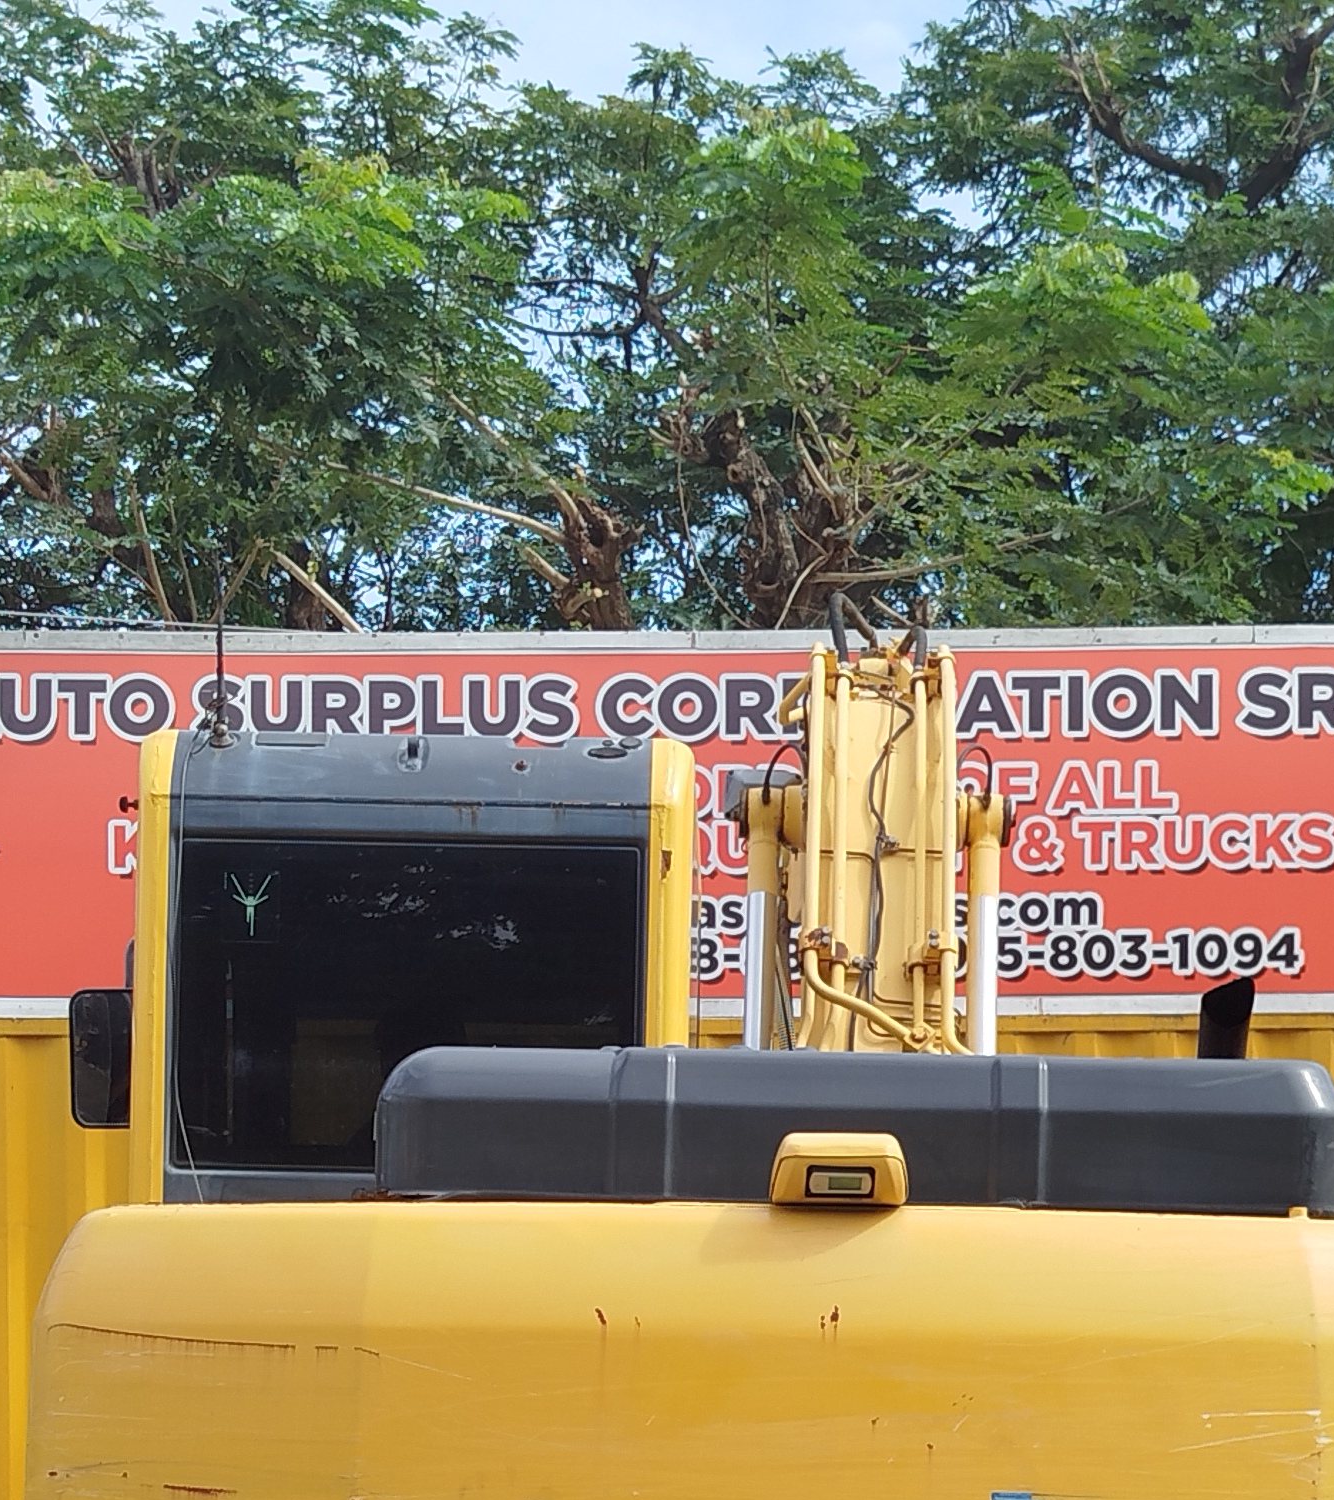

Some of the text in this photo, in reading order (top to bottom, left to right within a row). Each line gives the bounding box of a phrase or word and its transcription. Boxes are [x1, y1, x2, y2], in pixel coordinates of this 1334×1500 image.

[196, 676, 574, 737] SURPLUS
[599, 672, 1216, 738] CORATION
[1050, 762, 1174, 813] ALL
[1015, 818, 1062, 869] &
[955, 931, 1303, 975] 5-803-1094
